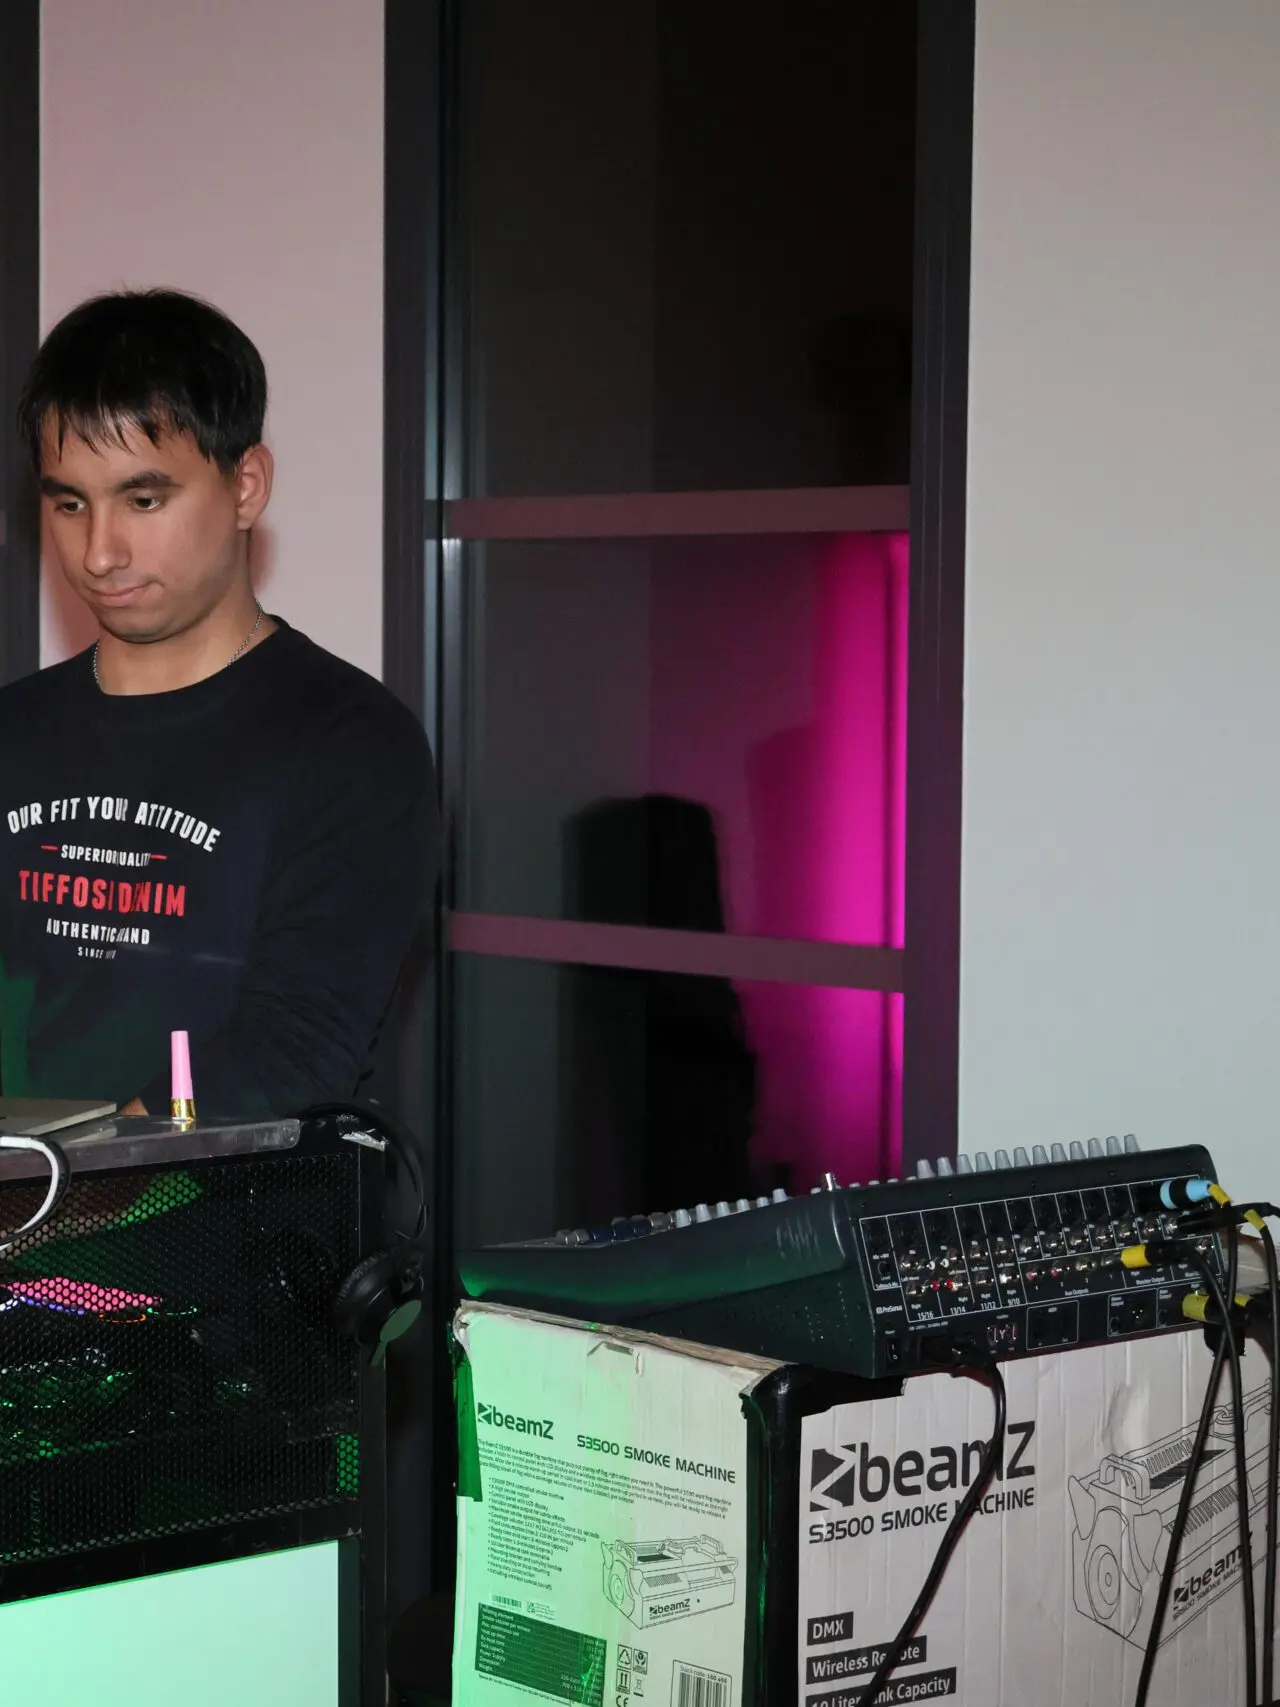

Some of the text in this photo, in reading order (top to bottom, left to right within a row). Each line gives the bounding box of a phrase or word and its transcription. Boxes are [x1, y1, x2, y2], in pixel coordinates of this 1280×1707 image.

[7, 802, 43, 834] OUR
[50, 797, 81, 823] FIT
[134, 801, 221, 853] ATTITUDE
[917, 1311, 934, 1320] 15/16
[950, 1306, 966, 1315] 13/14
[493, 1405, 554, 1440] beamZ
[577, 1434, 736, 1484] S3500 SMOKE MACHINE
[809, 1515, 875, 1544] S3500
[881, 1501, 948, 1533] SMOKE
[657, 1598, 691, 1614] beamZ
[812, 1619, 844, 1639] DMX
[812, 1656, 869, 1678] Wireless
[896, 1676, 951, 1701] Capacity
